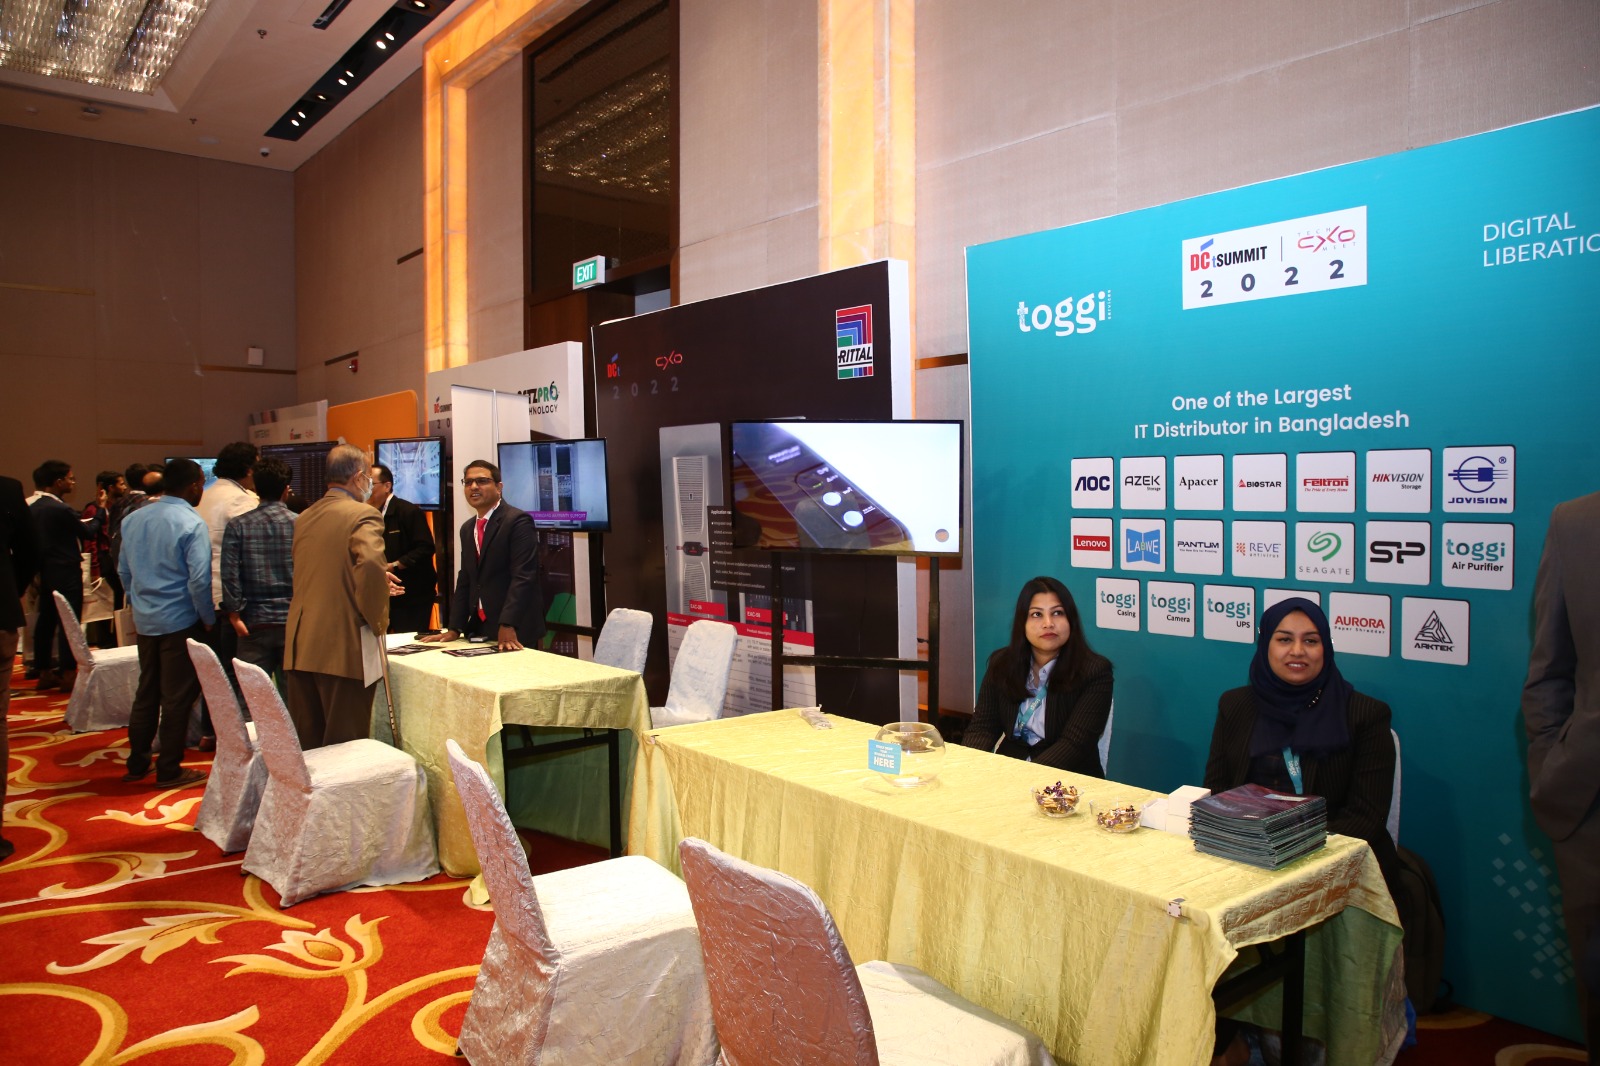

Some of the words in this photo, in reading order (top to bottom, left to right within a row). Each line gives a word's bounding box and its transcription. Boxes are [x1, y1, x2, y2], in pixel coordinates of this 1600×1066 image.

[1483, 212, 1576, 242] DIGITAL
[1483, 233, 1600, 267] LIBERATIO
[576, 263, 595, 283] EXIT
[1016, 291, 1106, 337] toggi
[838, 346, 873, 364] RITTAL
[1171, 395, 1208, 411] One
[1213, 391, 1231, 408] of
[1236, 390, 1268, 407] the
[1274, 384, 1352, 408] Largest
[529, 404, 558, 415] HNOLOGY
[1134, 424, 1148, 439] IT
[1153, 419, 1249, 438] Distributor
[1254, 416, 1272, 434] in
[1278, 410, 1410, 437] Bangladesh
[1074, 475, 1111, 491] AOC
[1179, 476, 1219, 490] Apacer
[1303, 477, 1349, 487] Feltron
[1372, 473, 1424, 483] HIKVISION
[1076, 538, 1107, 548] Lenovo
[1249, 543, 1279, 553] REVE
[1446, 539, 1506, 562] toggi
[1370, 540, 1426, 564] SP
[1299, 566, 1351, 576] SEAGATE
[1452, 561, 1466, 570] Air
[1467, 562, 1504, 572] Purifier
[1100, 590, 1136, 609] toggi
[1151, 594, 1191, 614] toggi
[1117, 609, 1136, 618] Casing
[1207, 598, 1251, 619] toggi
[1166, 615, 1190, 623] Camera
[1236, 620, 1250, 628] UPS
[1334, 615, 1385, 630] AURORA
[873, 756, 895, 769] HERE
